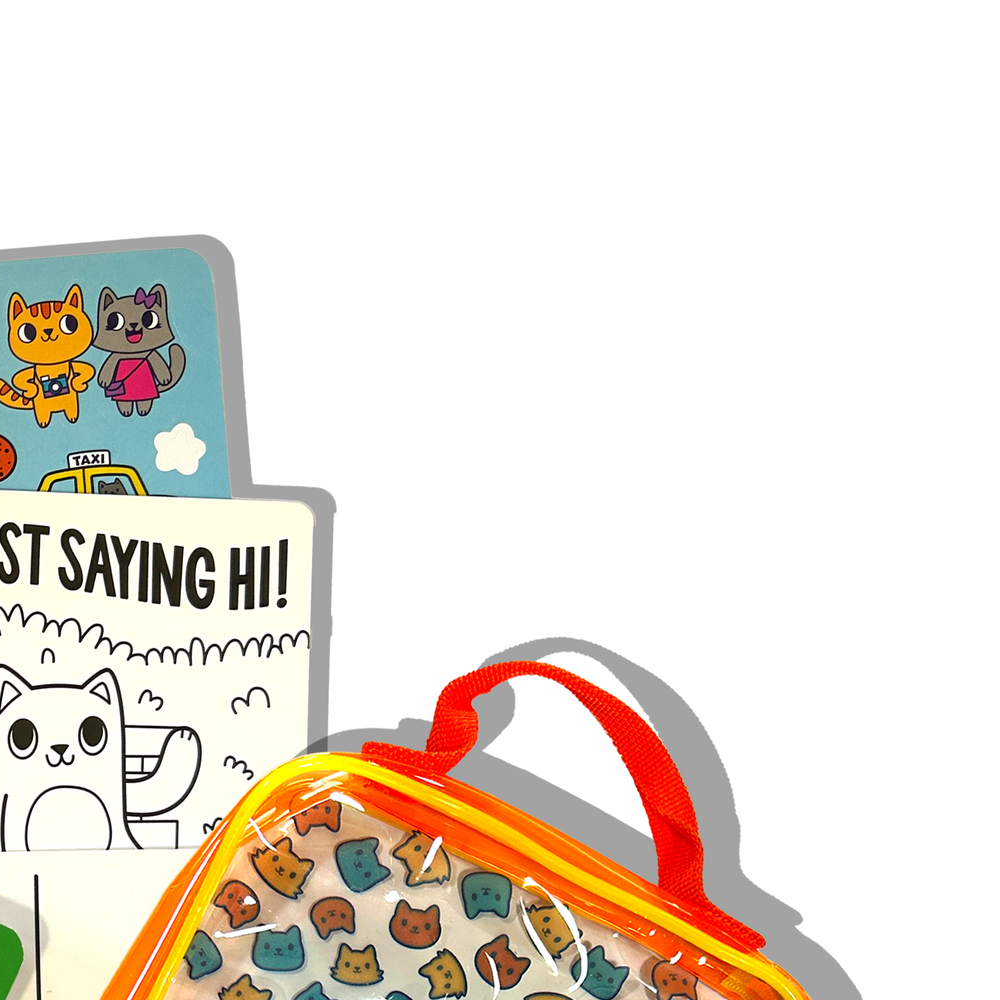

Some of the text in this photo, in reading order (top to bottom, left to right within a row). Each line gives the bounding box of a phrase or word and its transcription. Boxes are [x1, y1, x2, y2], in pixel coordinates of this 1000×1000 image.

[72, 453, 105, 466] TAXI
[57, 528, 216, 610] SAYING
[228, 538, 289, 611] HI!
